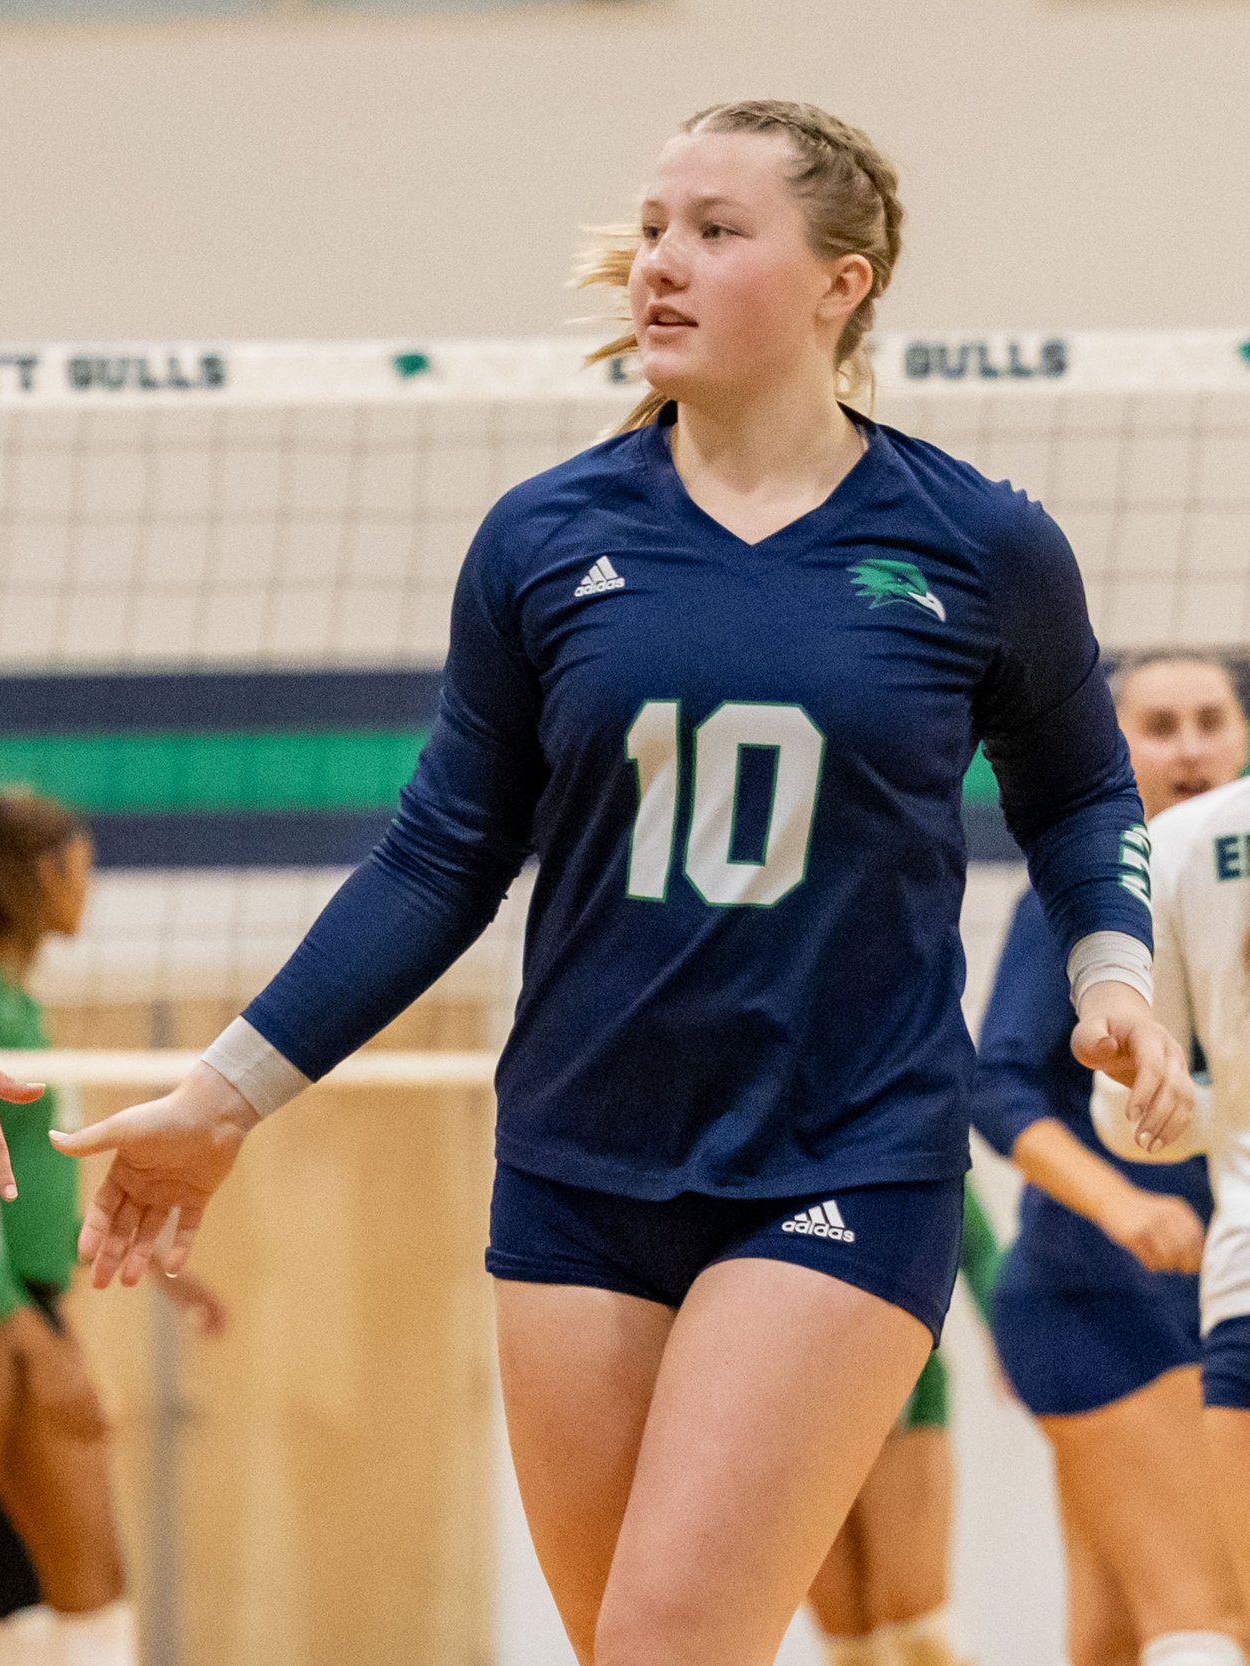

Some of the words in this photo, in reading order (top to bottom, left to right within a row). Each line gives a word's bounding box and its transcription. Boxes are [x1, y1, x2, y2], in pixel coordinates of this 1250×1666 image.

[573, 577, 626, 597] adidas
[625, 699, 827, 909] 10
[781, 1220, 855, 1243] adidas
